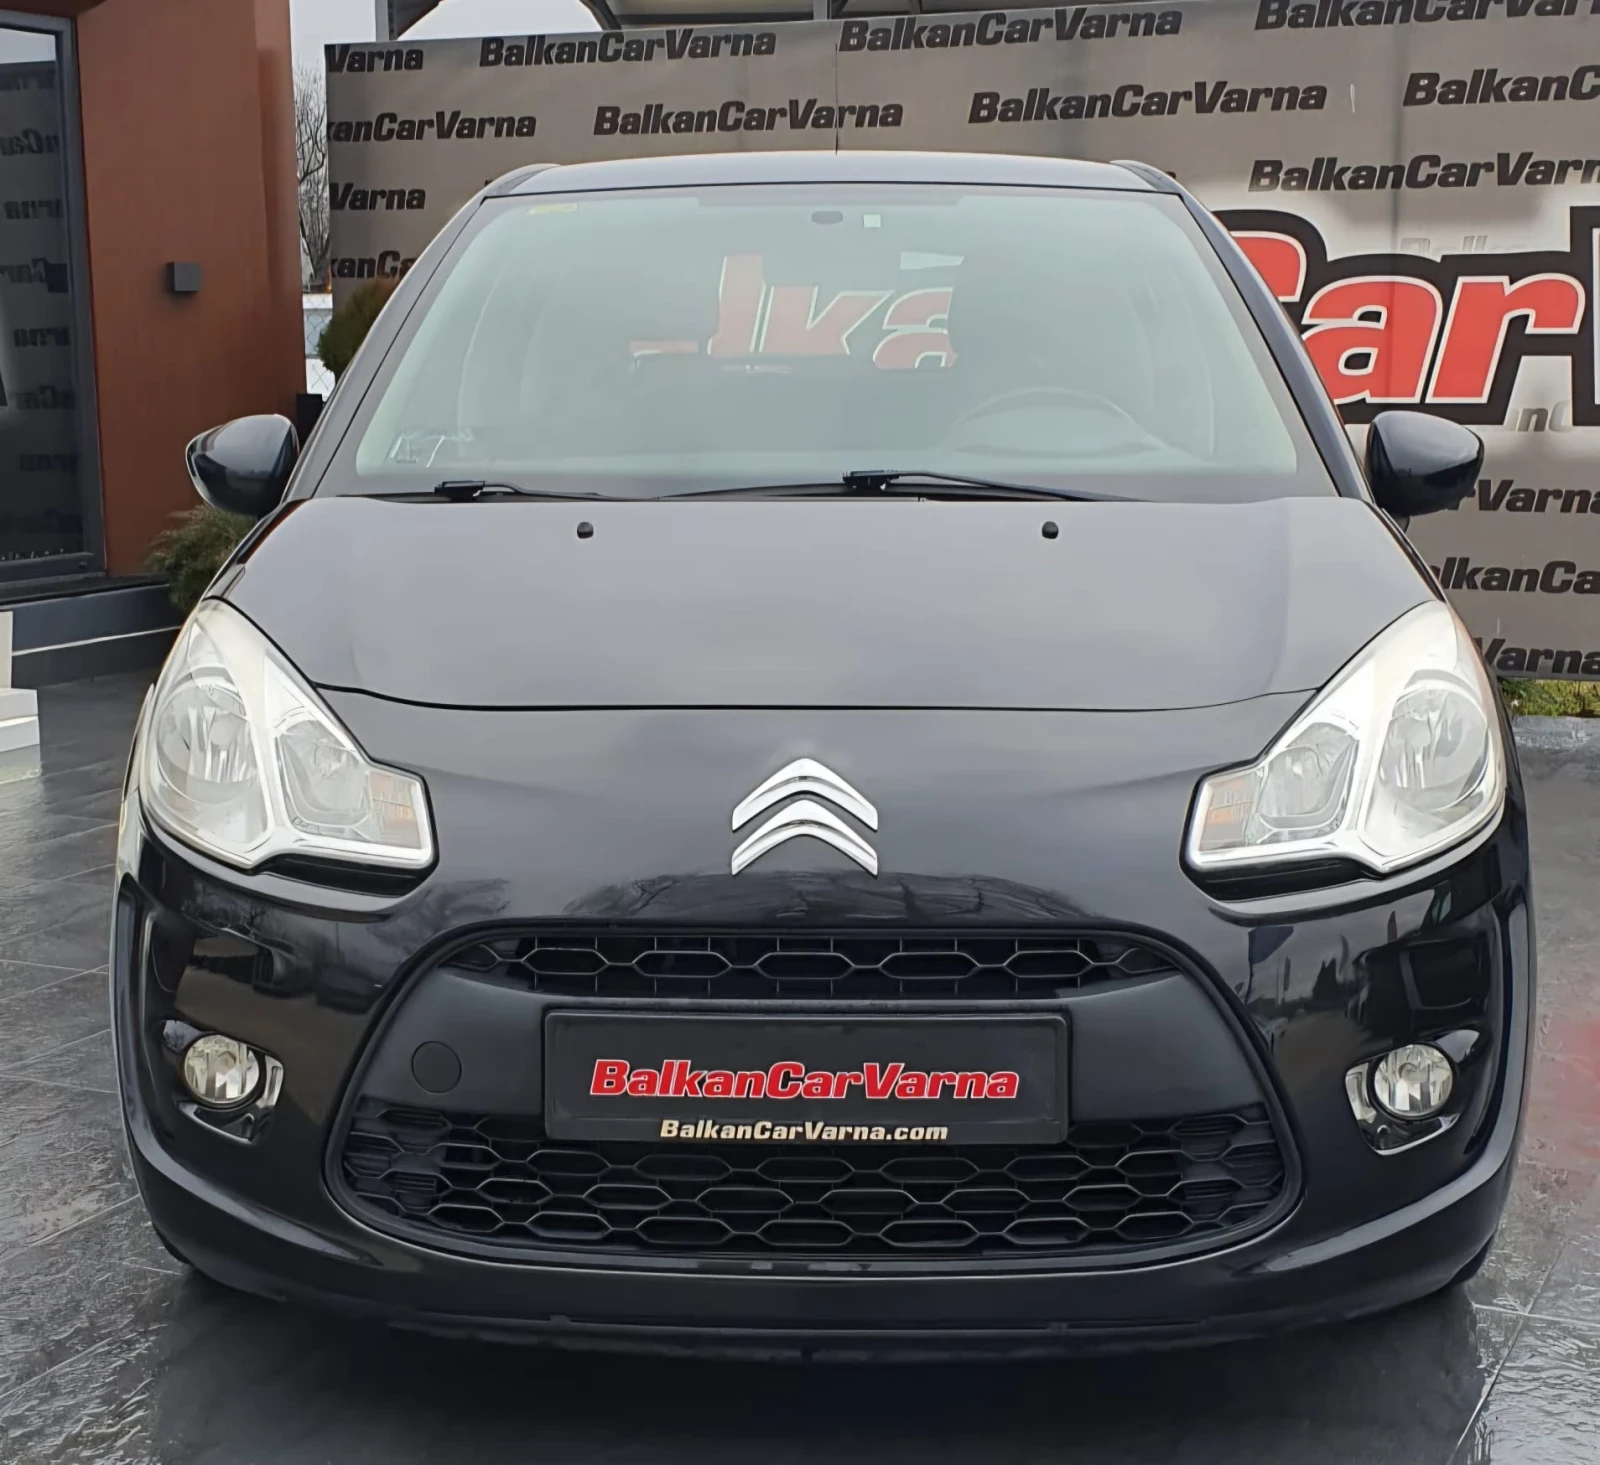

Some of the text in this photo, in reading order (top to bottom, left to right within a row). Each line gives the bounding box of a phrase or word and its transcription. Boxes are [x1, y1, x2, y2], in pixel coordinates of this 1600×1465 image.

[479, 29, 776, 67] BalkanCarVarna
[839, 8, 1182, 52] BalkanCarVarna
[593, 98, 904, 136] BalkanCarVarna
[968, 81, 1328, 124] BalkanCarVarna
[590, 1059, 1020, 1099] BalkanCarVarna
[660, 1119, 949, 1142] BalkanCarVarna.com
